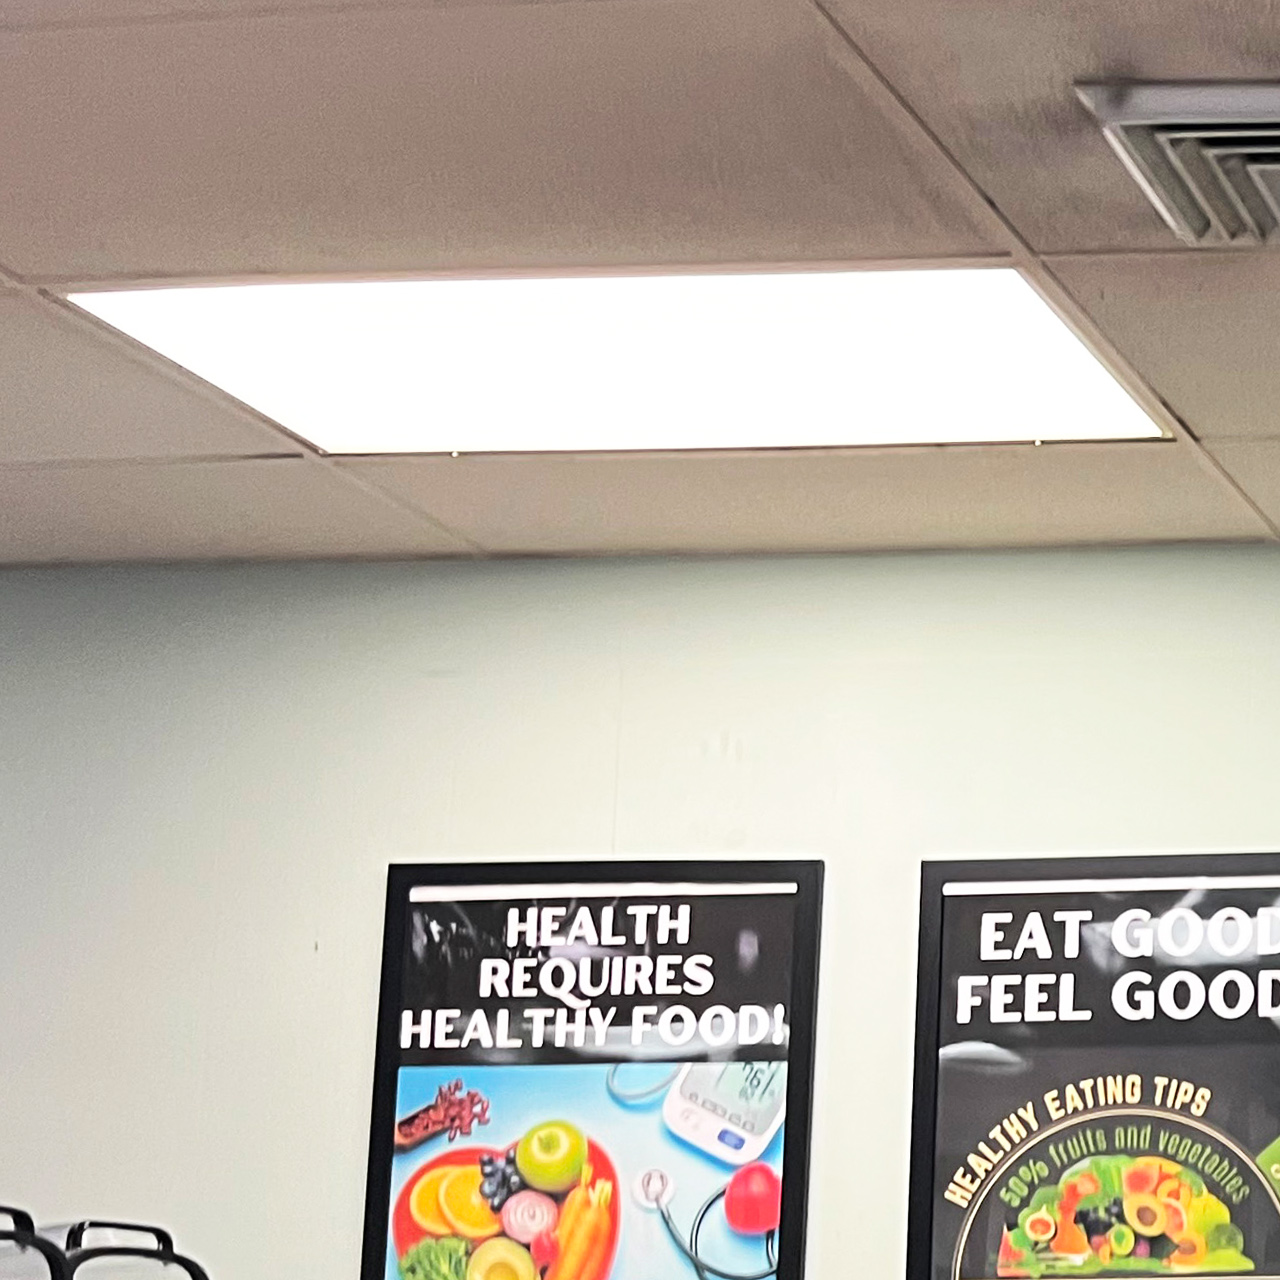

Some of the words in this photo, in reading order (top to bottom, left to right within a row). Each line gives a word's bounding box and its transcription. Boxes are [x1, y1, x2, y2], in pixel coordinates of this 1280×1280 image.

[506, 904, 692, 948] HEALTH
[980, 909, 1093, 961] EAT
[478, 954, 715, 1010] REQUIRES
[957, 972, 1093, 1024] FEEL
[400, 1005, 617, 1049] HEALTHY
[631, 1003, 786, 1047] FOOD!
[944, 1101, 1039, 1209] HEALTHY
[1043, 1073, 1142, 1122] EATING
[1154, 1075, 1213, 1117] TIPS
[999, 1158, 1050, 1208] 50%
[1115, 1123, 1152, 1151] and
[1158, 1128, 1251, 1205] vegetables
